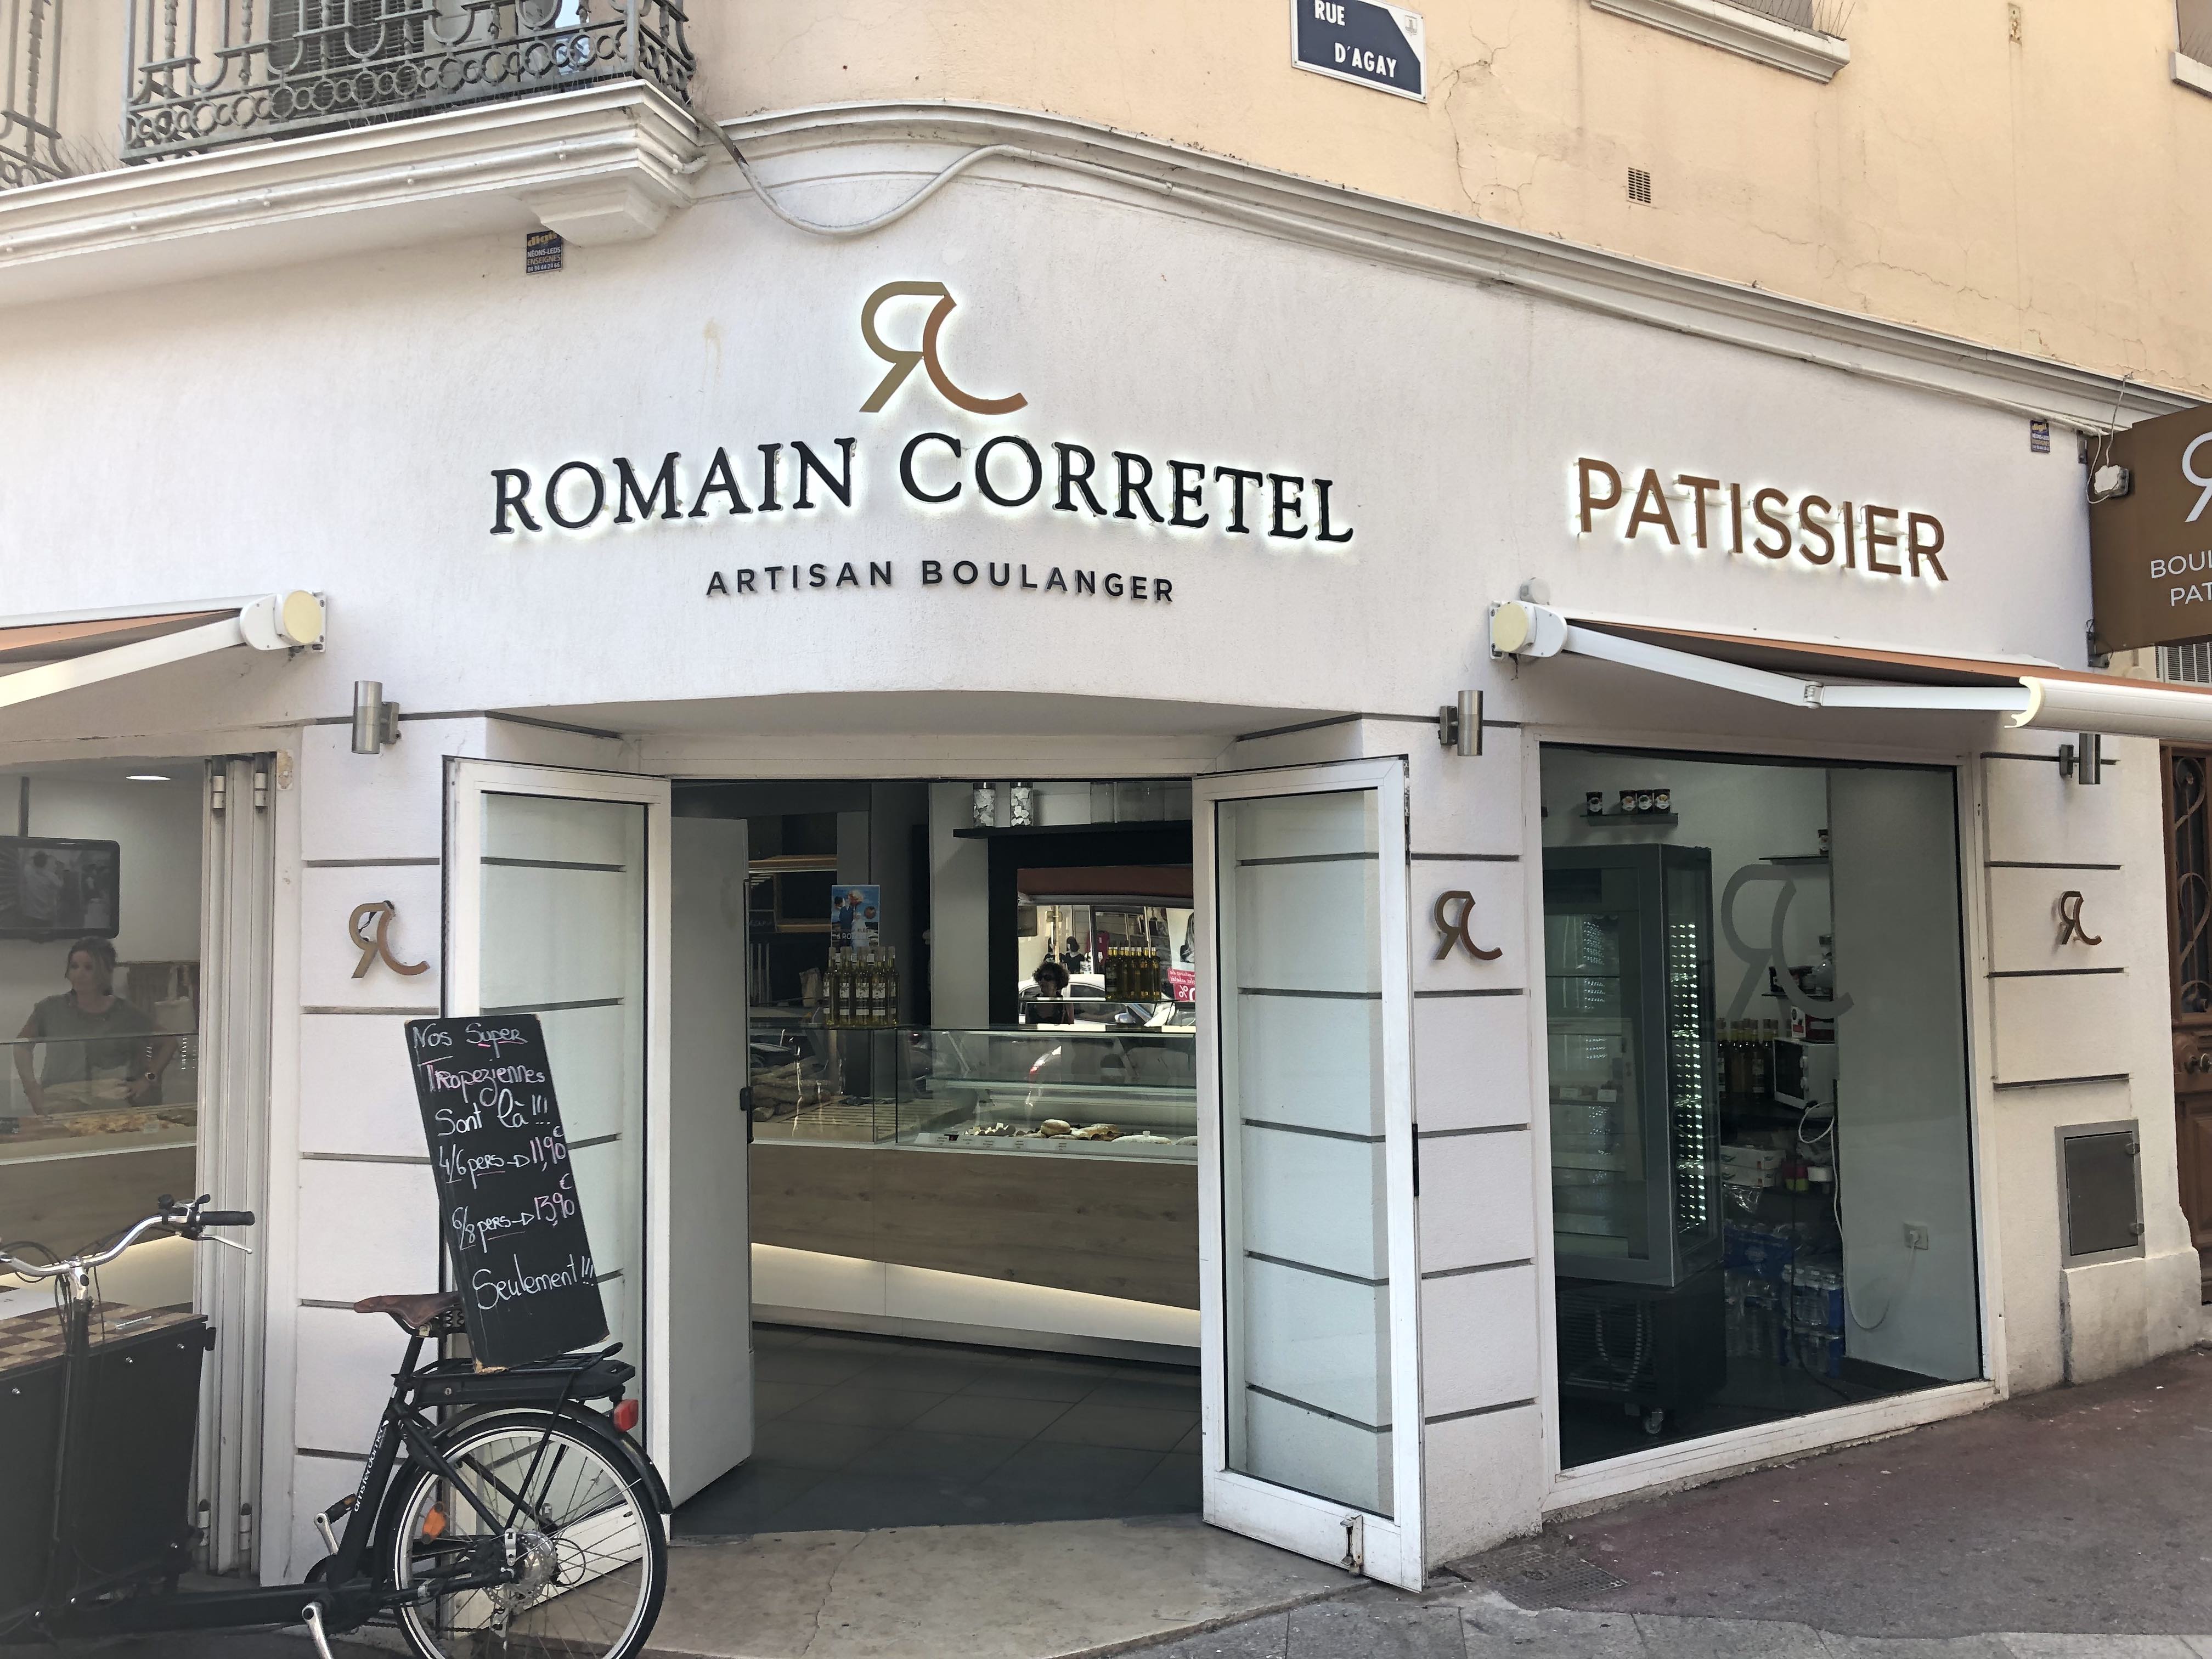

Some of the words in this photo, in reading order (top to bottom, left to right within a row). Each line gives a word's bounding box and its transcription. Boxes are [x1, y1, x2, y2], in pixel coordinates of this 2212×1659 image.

[1314, 0, 1345, 26] RUE
[1335, 42, 1397, 78] D'AGAY
[527, 254, 561, 266] ENSEIGNES
[490, 437, 856, 535] ROMAIN
[900, 432, 1353, 543] CORRETEL
[1577, 457, 1949, 581] PATISSIER
[706, 561, 892, 596] ARTISAN
[922, 560, 1173, 603] BOULANGER
[2170, 582, 2212, 607] PAT
[413, 1023, 453, 1048] Nos
[435, 1102, 483, 1136] Sont
[497, 1088, 529, 1128] là
[472, 1254, 578, 1310] Seulement
